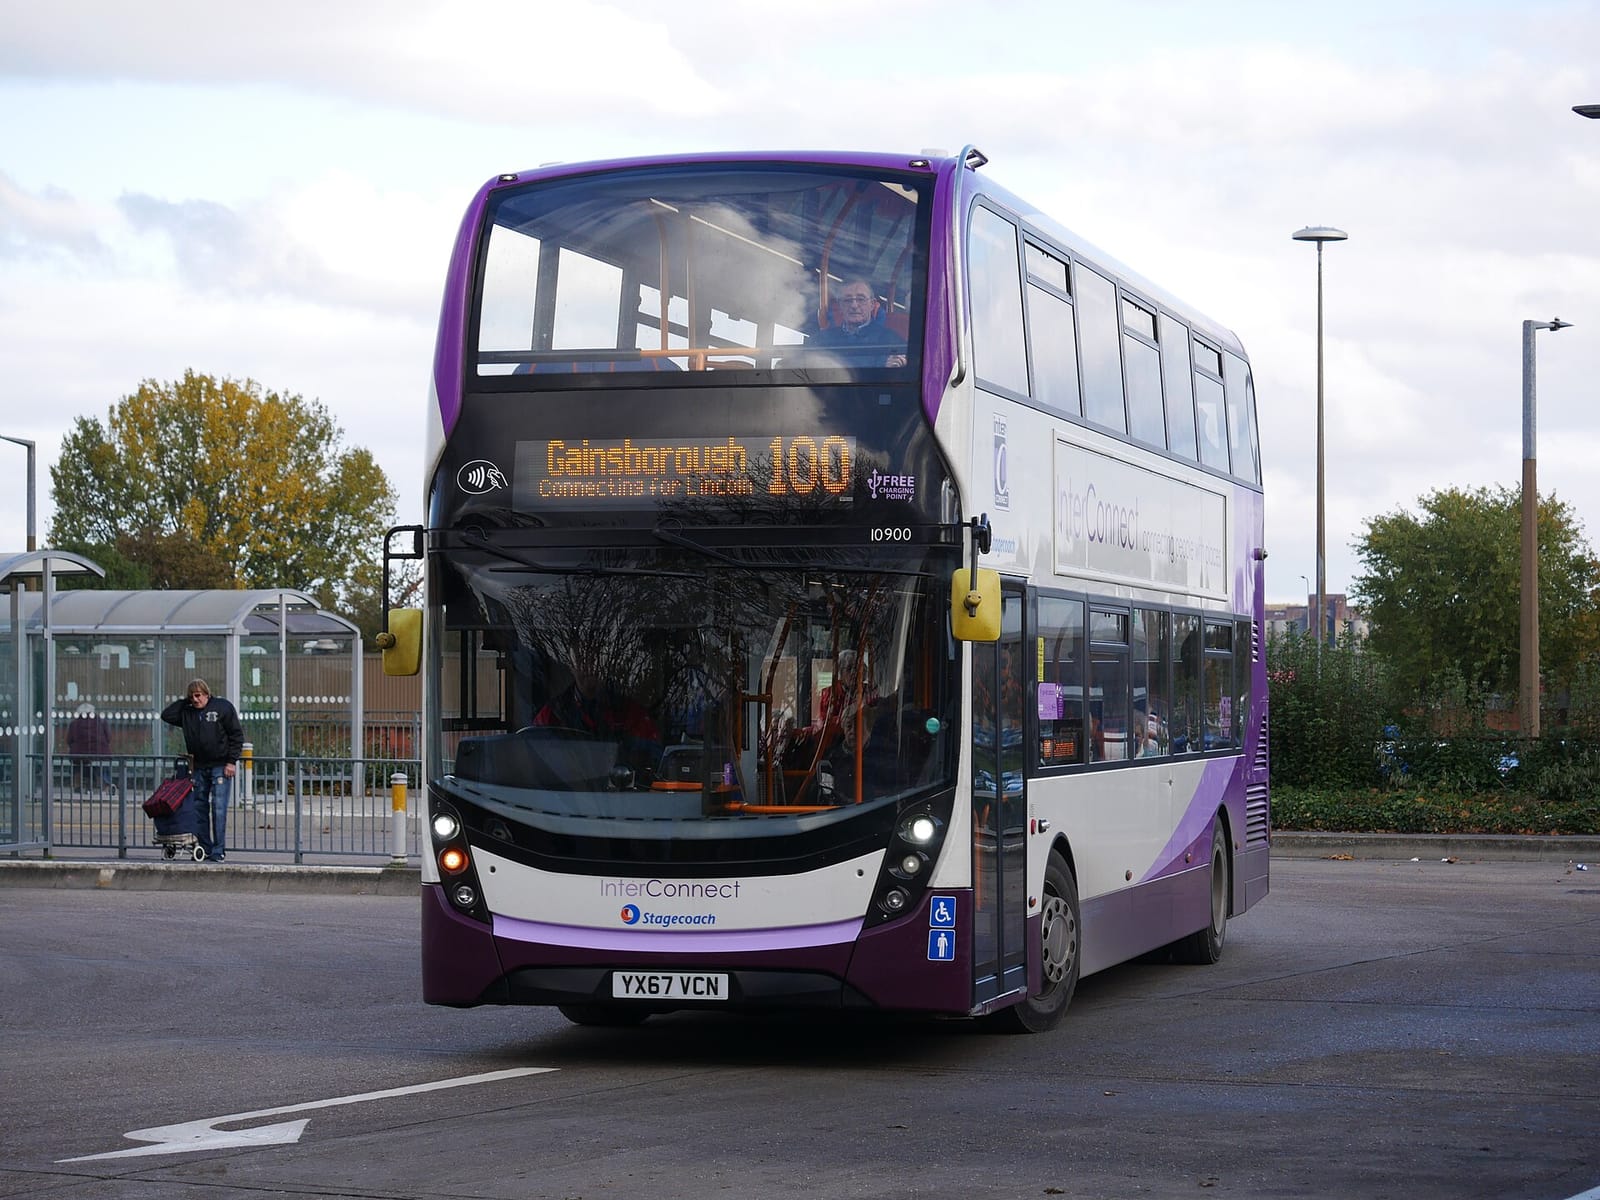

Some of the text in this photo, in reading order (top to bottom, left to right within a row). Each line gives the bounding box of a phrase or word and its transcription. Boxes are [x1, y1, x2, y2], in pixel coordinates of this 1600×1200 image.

[547, 436, 746, 476] Gainsborough
[768, 435, 850, 495] 100
[539, 476, 753, 497] Connecting for Lincoln
[882, 476, 915, 487] FREE
[1057, 475, 1139, 551] InterConnect
[870, 527, 912, 542] 10900
[600, 879, 741, 899] InterConnect
[642, 912, 716, 928] Stagecoach
[621, 975, 719, 996] YX67 VCN
